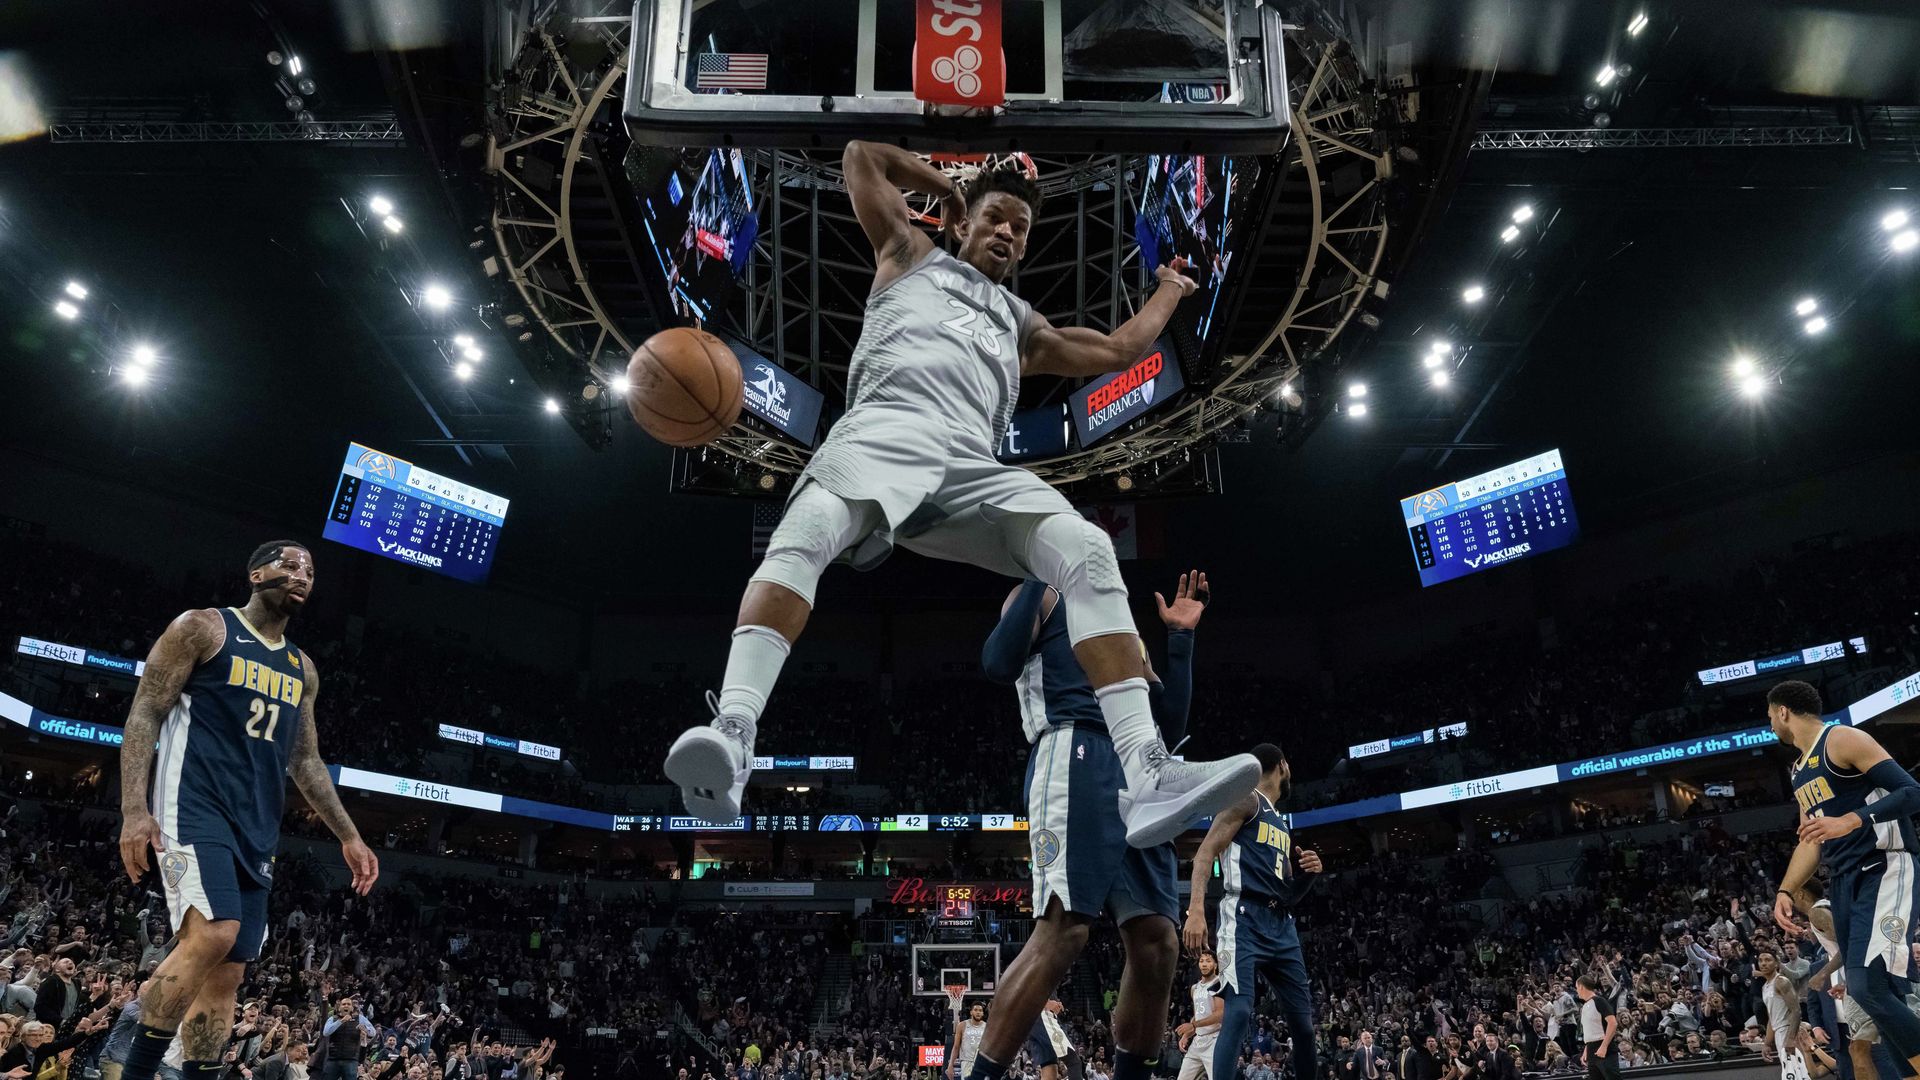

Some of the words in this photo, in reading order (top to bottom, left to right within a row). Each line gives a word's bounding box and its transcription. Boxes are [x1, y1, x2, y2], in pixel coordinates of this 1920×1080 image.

[1192, 88, 1210, 99] NBA
[940, 298, 1011, 357] 23
[1086, 352, 1162, 416] FEDERATED
[743, 381, 766, 406] reasure
[770, 400, 791, 420] Island
[1088, 388, 1142, 431] INSURANCE
[366, 494, 379, 502] 4/7
[370, 484, 382, 494] 1/2
[420, 502, 432, 510] 0/0
[362, 511, 374, 519] 0/3
[388, 520, 400, 528] 0/2
[364, 502, 376, 510] 3/6
[391, 511, 403, 520] 1/2
[359, 520, 371, 528] 1/3
[386, 528, 398, 536] 0/0
[394, 545, 417, 559] JACK
[1483, 550, 1505, 564] JACK
[1719, 665, 1750, 680] fitbit
[226, 655, 303, 709] DENVER
[40, 720, 96, 739] official
[533, 746, 556, 758] fitbit
[1364, 743, 1386, 755] fitbit
[1572, 758, 1617, 776] official
[1619, 743, 1684, 767] wearable
[1687, 741, 1704, 755] of
[1705, 736, 1731, 752] the
[825, 759, 848, 768] fitbit
[414, 782, 450, 801] fitbit
[1467, 779, 1502, 796] fitbit
[905, 817, 920, 827] 42
[941, 817, 969, 827] 6:52
[990, 817, 1005, 826] 37
[1274, 851, 1284, 880] 5
[948, 888, 971, 899] 6:52
[945, 900, 968, 917] 24
